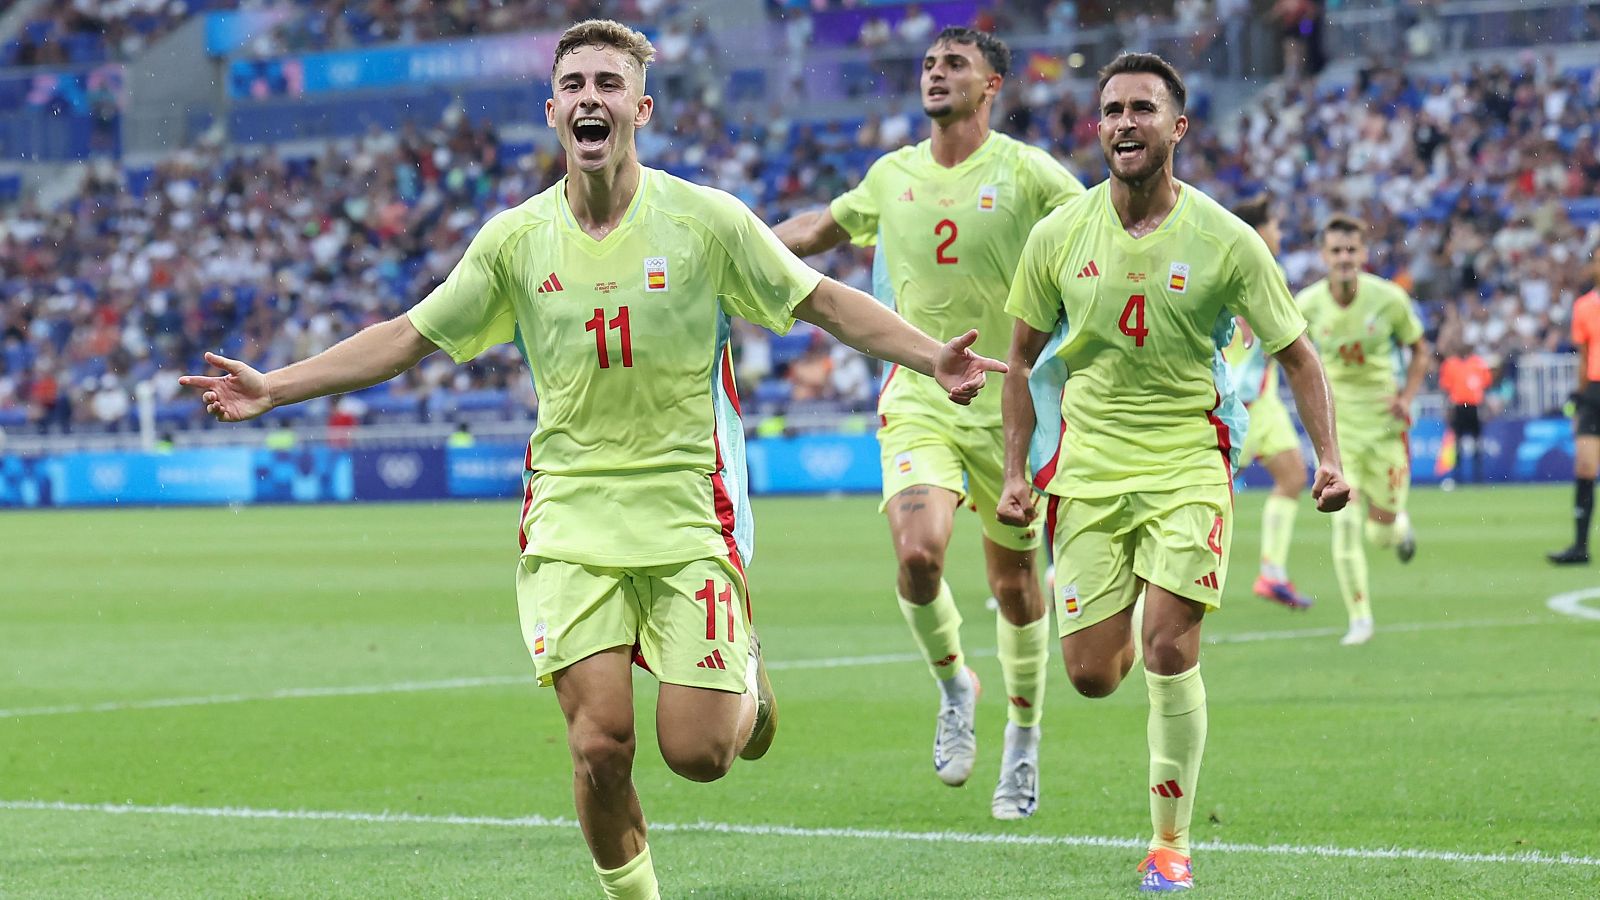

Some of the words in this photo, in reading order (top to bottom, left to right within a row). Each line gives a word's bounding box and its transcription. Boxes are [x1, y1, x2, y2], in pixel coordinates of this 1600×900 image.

[934, 218, 959, 265] 2
[584, 305, 633, 369] 11
[1118, 294, 1149, 347] 4
[695, 579, 735, 642] 11
